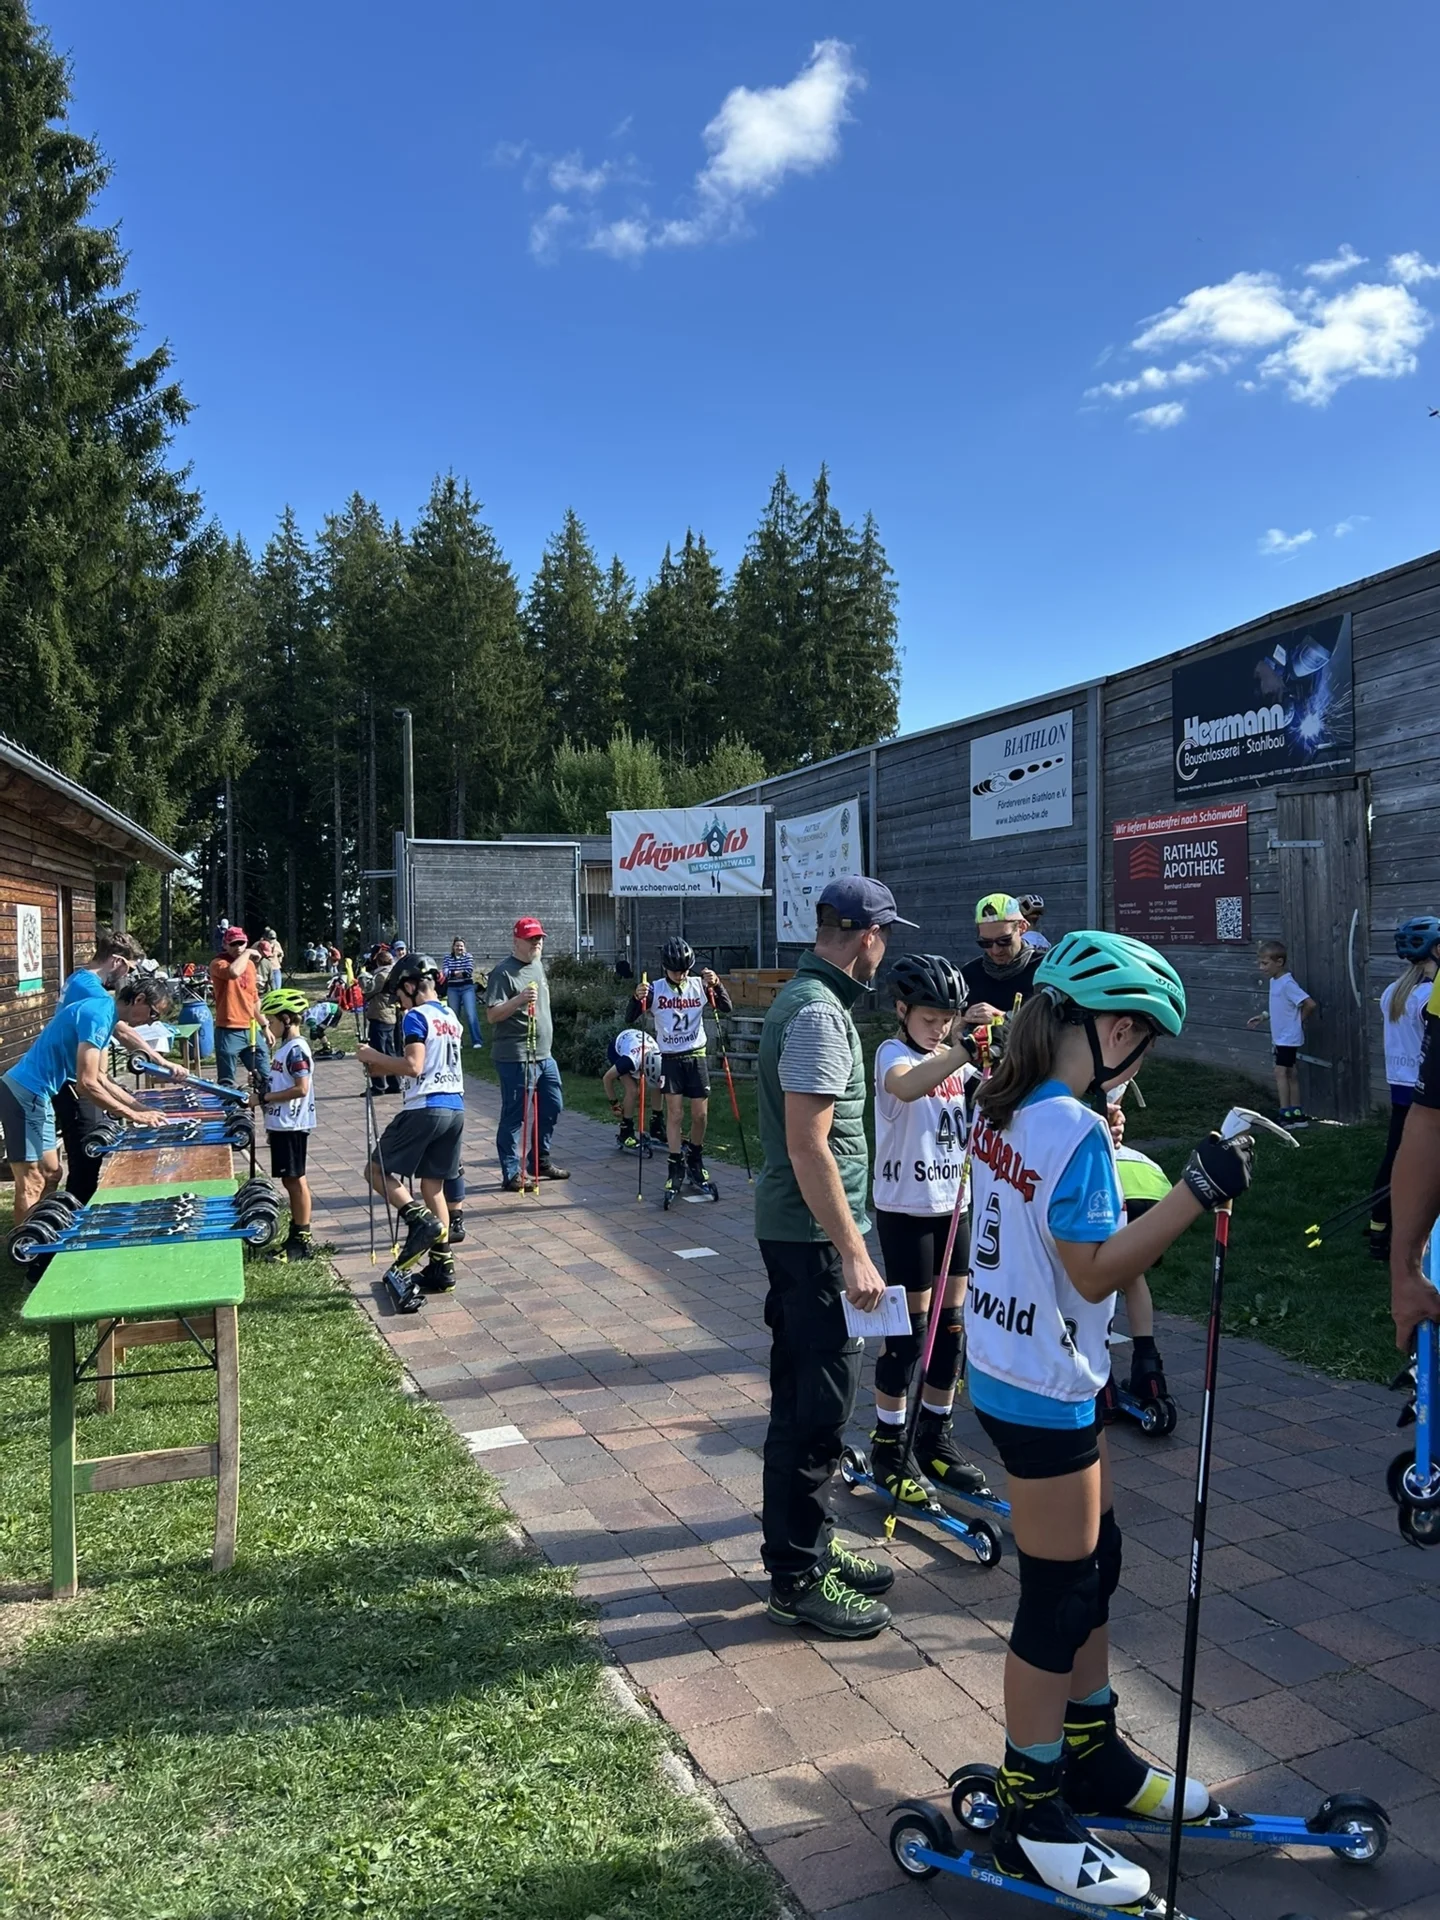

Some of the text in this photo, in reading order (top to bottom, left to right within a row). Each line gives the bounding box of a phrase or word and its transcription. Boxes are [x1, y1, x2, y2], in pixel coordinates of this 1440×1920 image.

[1183, 703, 1285, 748] Herrmann
[1004, 723, 1068, 758] BIATHLON
[1184, 735, 1285, 766] Bauschlosserei Stahlbau
[997, 788, 1067, 811] Förderverein Biathlon e.V.
[995, 809, 1048, 825] www.biathlon-bw.de
[1115, 823, 1127, 835] Wir
[1127, 820, 1147, 834] liefern
[1147, 815, 1180, 831] kostenfrei
[1181, 813, 1198, 824] nach
[619, 827, 749, 872] Schönwld
[1163, 840, 1218, 861] RATHAUS
[1163, 858, 1226, 879] APOTHEKE
[619, 883, 701, 893] www.schoenwald.net
[657, 996, 702, 1011] Rothaus
[672, 1013, 690, 1032] 21
[935, 1106, 968, 1153] 40
[979, 1870, 1004, 1887] SRB
